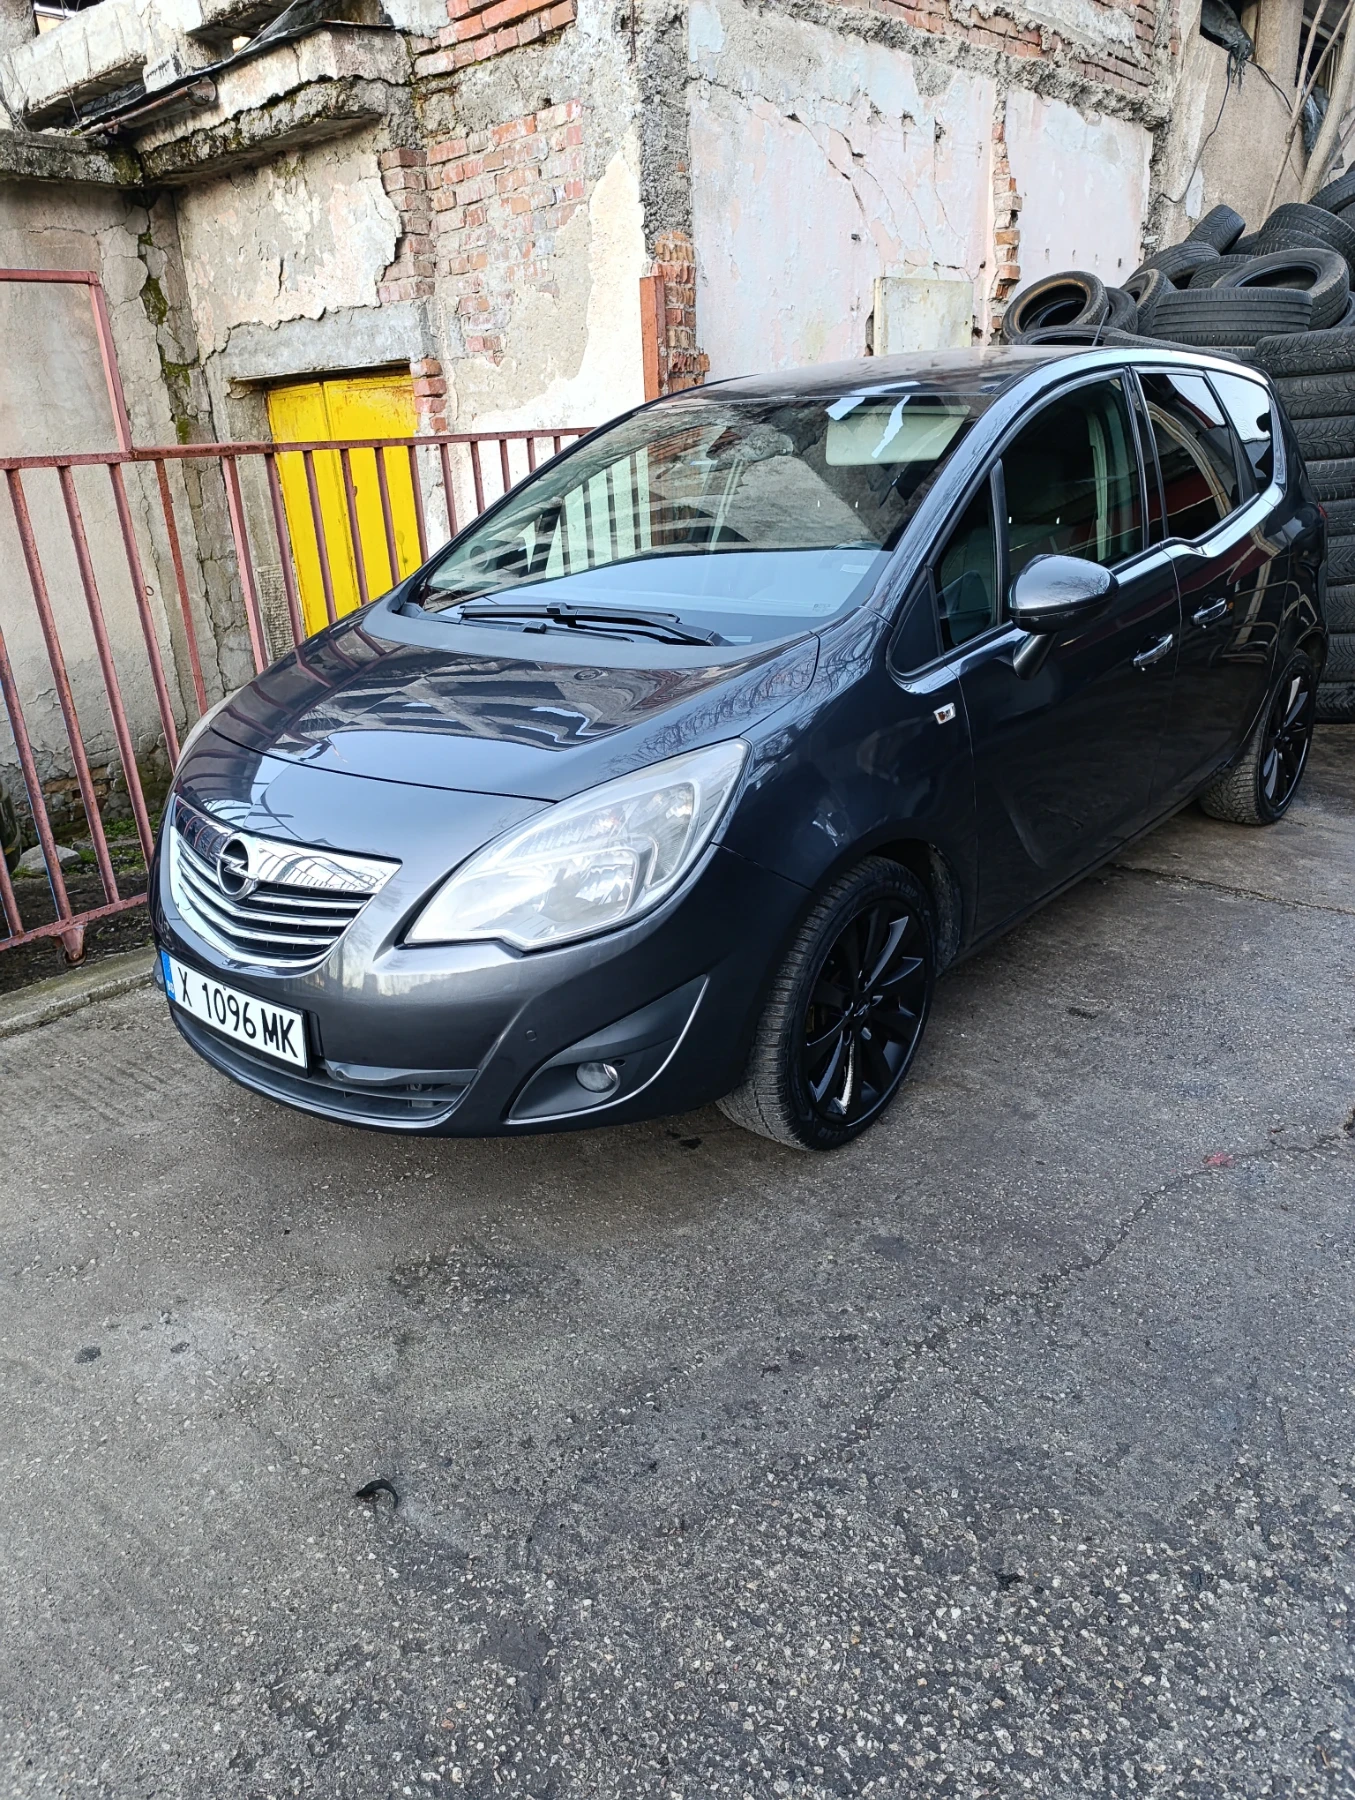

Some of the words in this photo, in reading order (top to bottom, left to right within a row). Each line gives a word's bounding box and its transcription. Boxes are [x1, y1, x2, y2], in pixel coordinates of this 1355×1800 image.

[177, 966, 193, 1008] X
[201, 982, 257, 1040] 1096
[260, 1007, 299, 1059] MK
